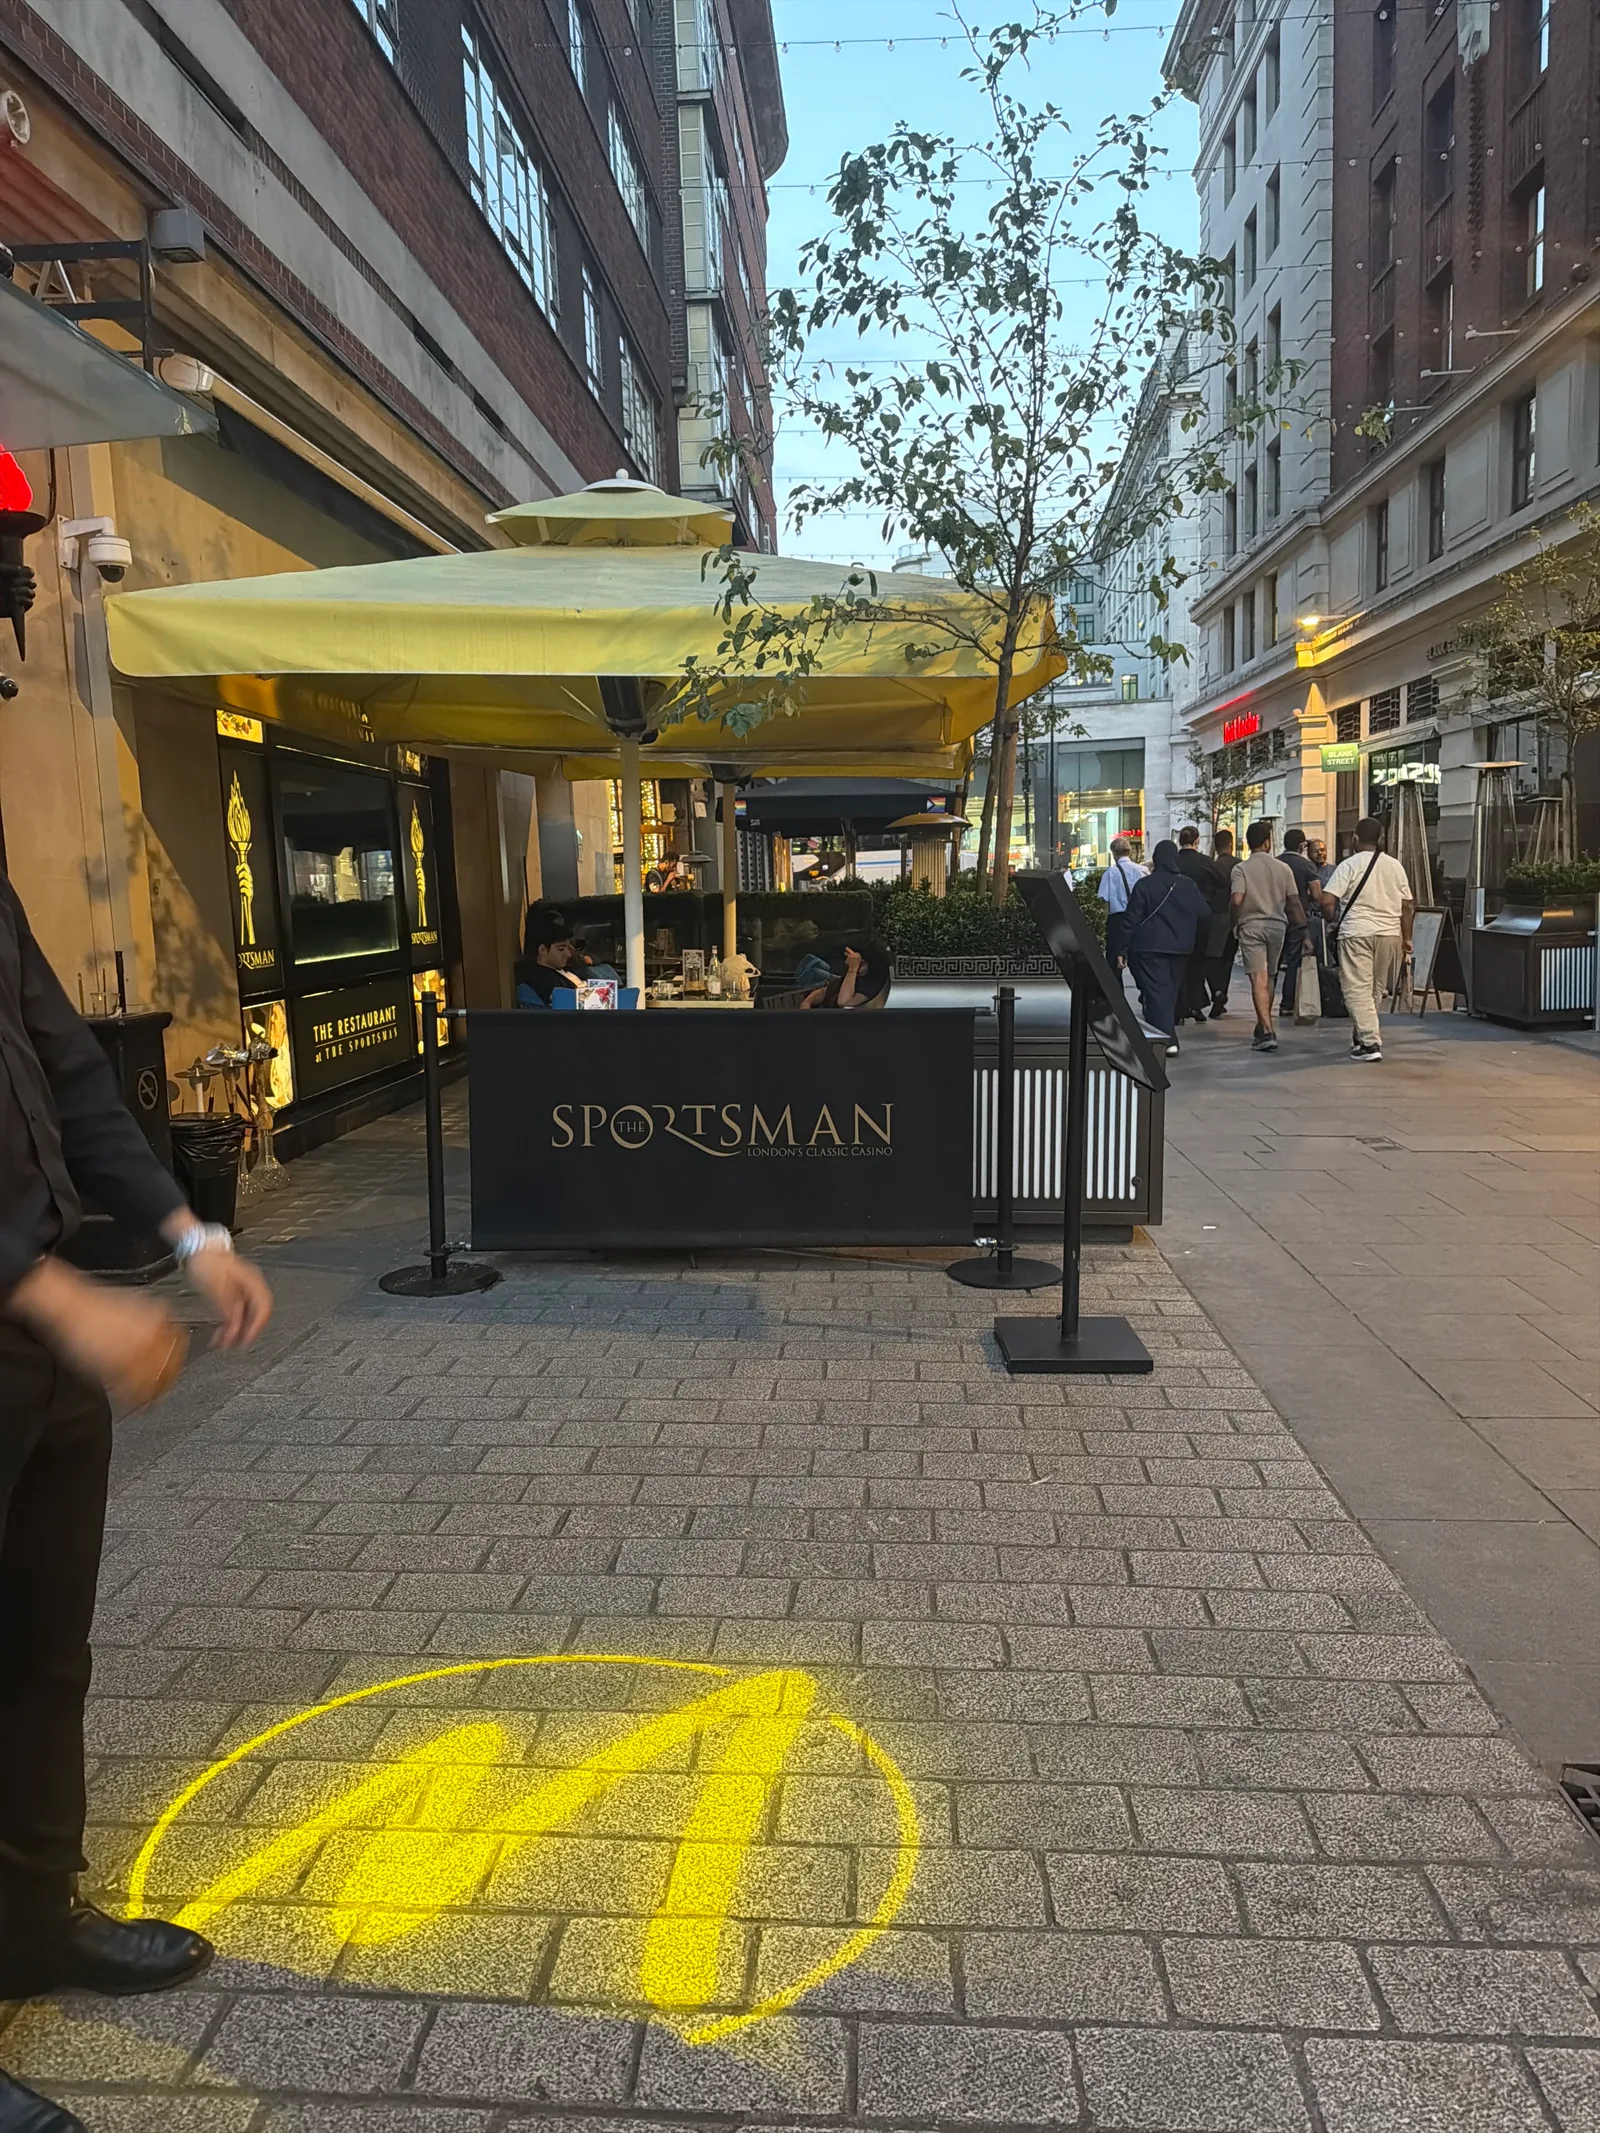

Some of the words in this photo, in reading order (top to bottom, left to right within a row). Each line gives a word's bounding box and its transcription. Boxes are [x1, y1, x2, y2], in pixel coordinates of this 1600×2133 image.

[1328, 750, 1353, 758] BLANK
[1327, 757, 1355, 766] STREET
[313, 1022, 333, 1042] THE
[338, 1006, 396, 1036] RESTAURANT
[325, 1044, 343, 1060] THE
[349, 1027, 398, 1052] SPORTSMAN
[551, 1103, 894, 1157] SPORTSMAN
[617, 1121, 645, 1133] THE
[748, 1147, 803, 1157] LONDON'S
[806, 1147, 848, 1157] CLASSIC
[851, 1147, 893, 1156] CASINO
